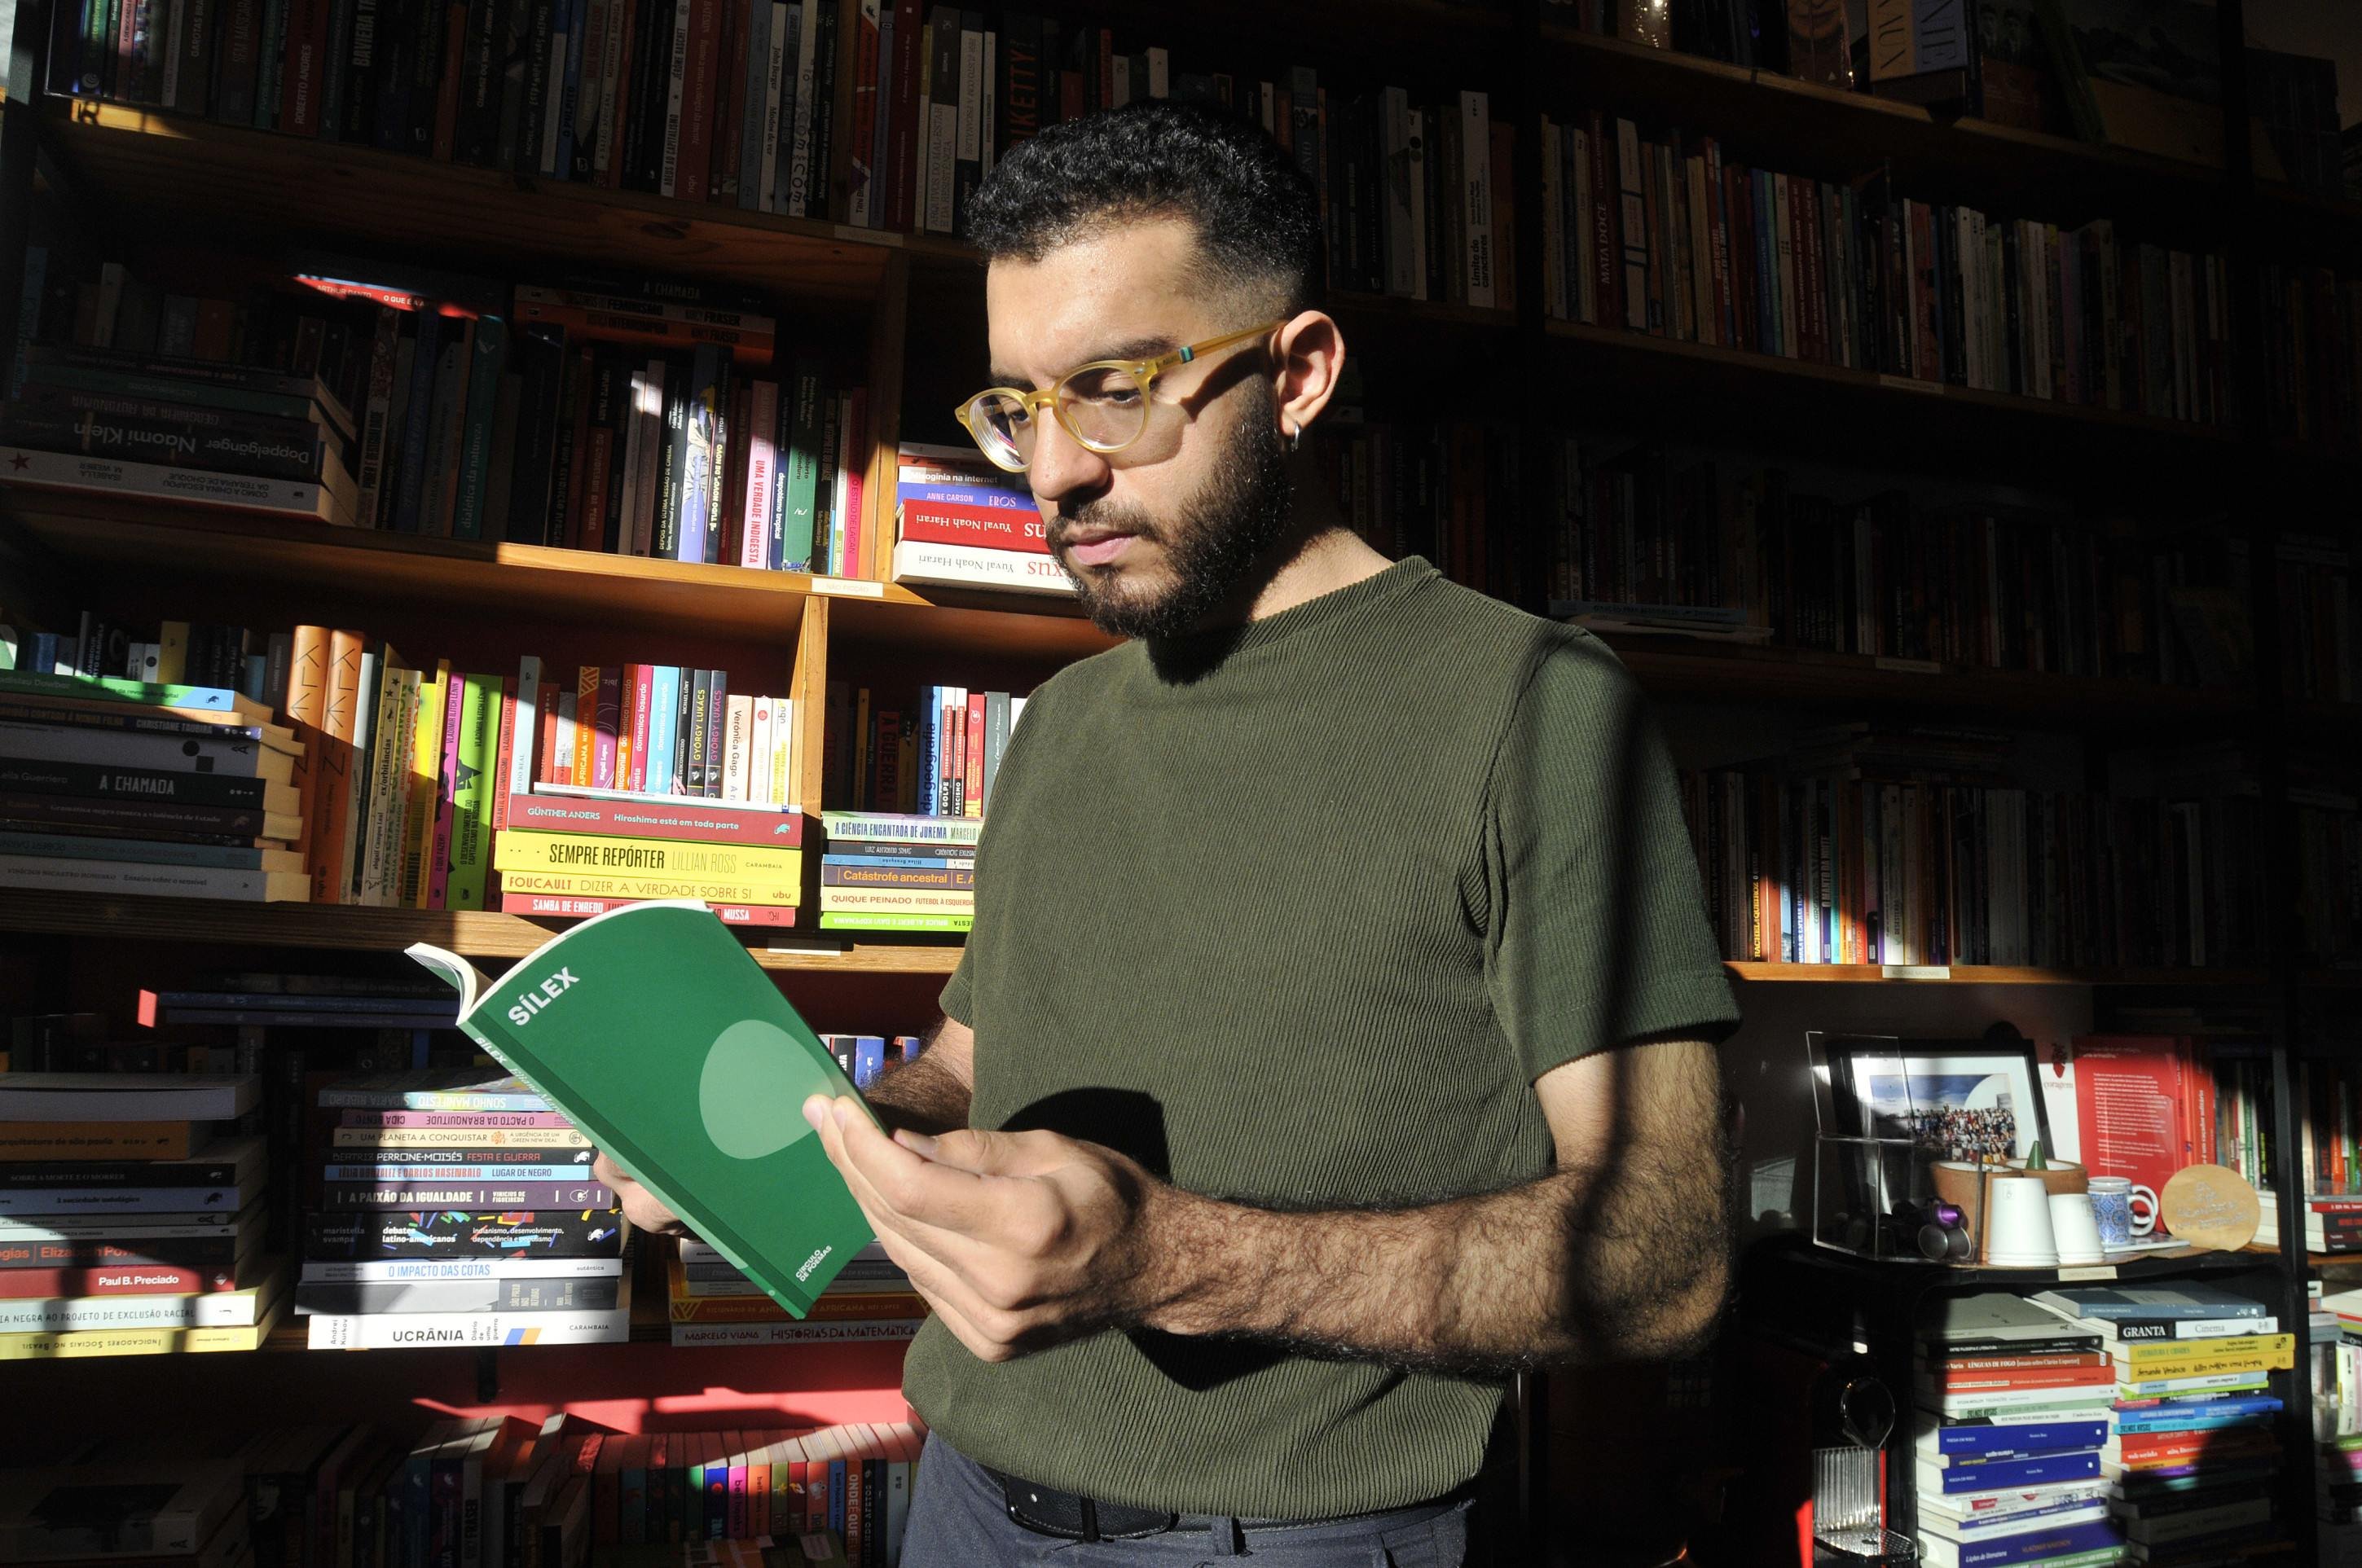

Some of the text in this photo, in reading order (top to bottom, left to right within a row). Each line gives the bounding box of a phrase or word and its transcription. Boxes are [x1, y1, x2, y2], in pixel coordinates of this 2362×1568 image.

[191, 20, 203, 57] GAROTAS
[352, 13, 375, 67] BAVIERA
[772, 45, 781, 64] John
[294, 45, 312, 125] ROBERTO ANDRES
[769, 64, 780, 91] Berger
[768, 105, 776, 129] Modos
[767, 130, 774, 140] de
[932, 162, 940, 176] DO
[930, 178, 941, 226] ARQUIVOS
[1597, 202, 1611, 284] MATA DOCE
[1480, 234, 1489, 288] caracteres
[1471, 257, 1481, 287] Limite
[74, 423, 310, 463] Doppelgänger Naomi Klein
[169, 472, 270, 490] DA TERAPIA DE CHOQUE
[462, 423, 482, 528] dialética da natureza
[662, 477, 670, 498] SESSÃO
[710, 503, 719, 521] TUDO
[715, 466, 722, 475] DE
[660, 499, 668, 519] ÚLTIMA
[774, 472, 785, 539] despotismo tropical
[850, 487, 859, 513] ESTILO
[926, 493, 1017, 507] ANNE CARSON EROS
[749, 460, 765, 563] UMA VERDADE INDIGESTA
[849, 515, 856, 525] DE
[661, 520, 666, 529] DA
[916, 515, 1012, 533] Yuval Noah Harari
[848, 527, 856, 554] LACAN
[919, 555, 1014, 573] Yuval Noah Harari
[636, 683, 647, 752] domenico losurdo
[710, 690, 722, 762] GYÖRGY LUKÁCS
[693, 722, 704, 761] GYÖRGY
[920, 723, 937, 810] da geografia
[99, 775, 108, 790] A
[114, 775, 174, 795] CHAMADA
[528, 806, 567, 819] GÜNTHER
[568, 809, 600, 821] ANDERS
[614, 813, 658, 824] Hiroshima
[659, 816, 678, 826] está
[694, 819, 714, 828] toda
[715, 821, 739, 832] parte
[835, 822, 976, 839] A CIÊNCIA ENCANTADA DE JUREMA MARCELO
[1821, 835, 1831, 859] NOITE
[1821, 861, 1831, 871] DA
[509, 876, 791, 899] FOUCAULT DIZER A VERDADE SOBRE SI ubu
[843, 871, 966, 884] Catástrofe ancestral E.
[1821, 872, 1831, 900] MANTO
[533, 899, 750, 920] SAMBA DE ENREDO MUSSA
[508, 966, 580, 1026] SÍLEX
[429, 1133, 487, 1141] CONQUISTAR
[492, 1169, 552, 1177] LUGAR DE NEGRO
[349, 1189, 473, 1202] A PAIXÃO DA IGUALDADE
[382, 1226, 416, 1235] debates
[382, 1234, 456, 1244] latino-americanos
[389, 1266, 395, 1277] O
[397, 1265, 439, 1278] IMPACTO
[441, 1266, 460, 1276] DAS
[461, 1264, 490, 1276] COTAS
[800, 1245, 832, 1282] DE POEMAS
[99, 1275, 179, 1286] Paul B. Preciado
[13, 1309, 195, 1323] NEGRA AO PROJETO DE EXCLUSÃO RACIAL
[393, 1329, 464, 1342] UCRÂNIA
[478, 1333, 484, 1341] de
[684, 1330, 727, 1340] MARCELO
[731, 1330, 759, 1339] VIANA
[771, 1327, 828, 1340] HISTÓRIAS
[829, 1328, 845, 1337] DA
[2123, 1324, 2225, 1337] GRANTA Cinema
[848, 1474, 859, 1506] ONDE
